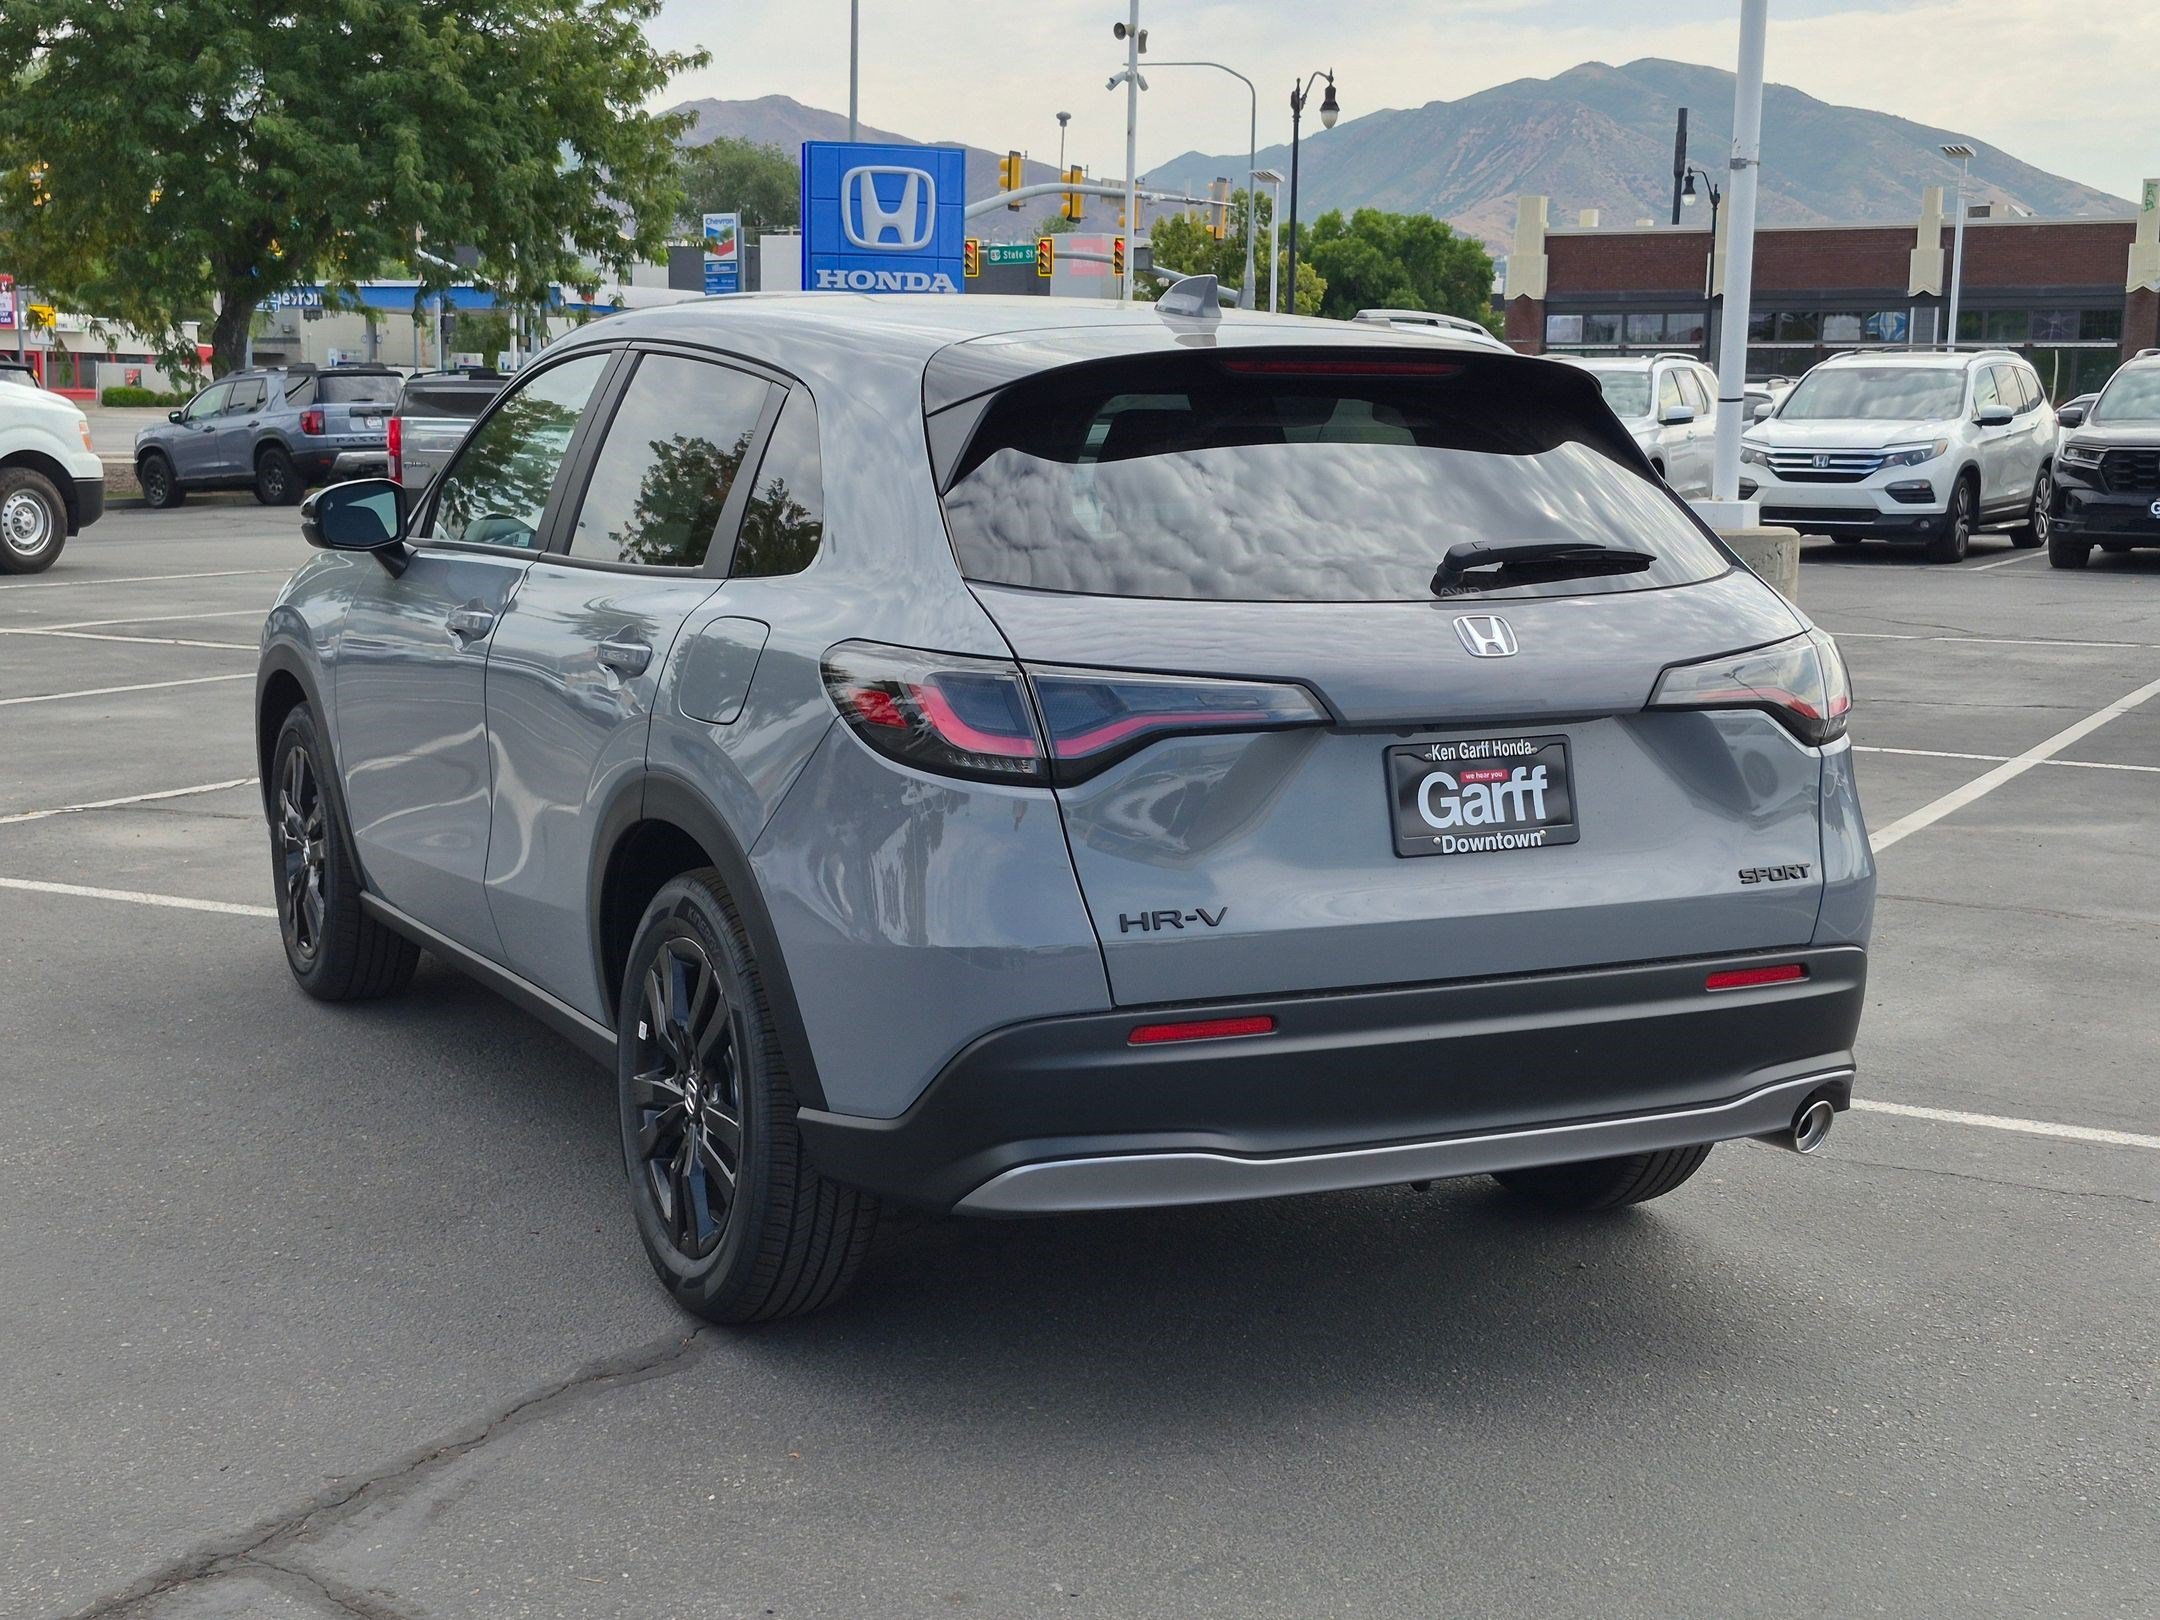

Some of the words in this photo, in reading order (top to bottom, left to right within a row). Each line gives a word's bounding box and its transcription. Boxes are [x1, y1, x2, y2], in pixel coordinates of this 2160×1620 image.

[705, 217, 735, 225] Chevron
[1003, 250, 1024, 260] State
[1025, 249, 1034, 259] St
[816, 269, 958, 292] HONDA
[1440, 586, 1480, 596] AWD
[1431, 744, 1456, 761] Ken
[1459, 741, 1490, 759] Garff
[1493, 739, 1533, 757] Honda
[1476, 771, 1490, 779] hear
[1491, 771, 1503, 780] you
[1417, 764, 1548, 829] Garff
[1441, 832, 1542, 854] Downtown
[1738, 863, 1810, 884] SPORT
[1119, 907, 1228, 933] HR-V
